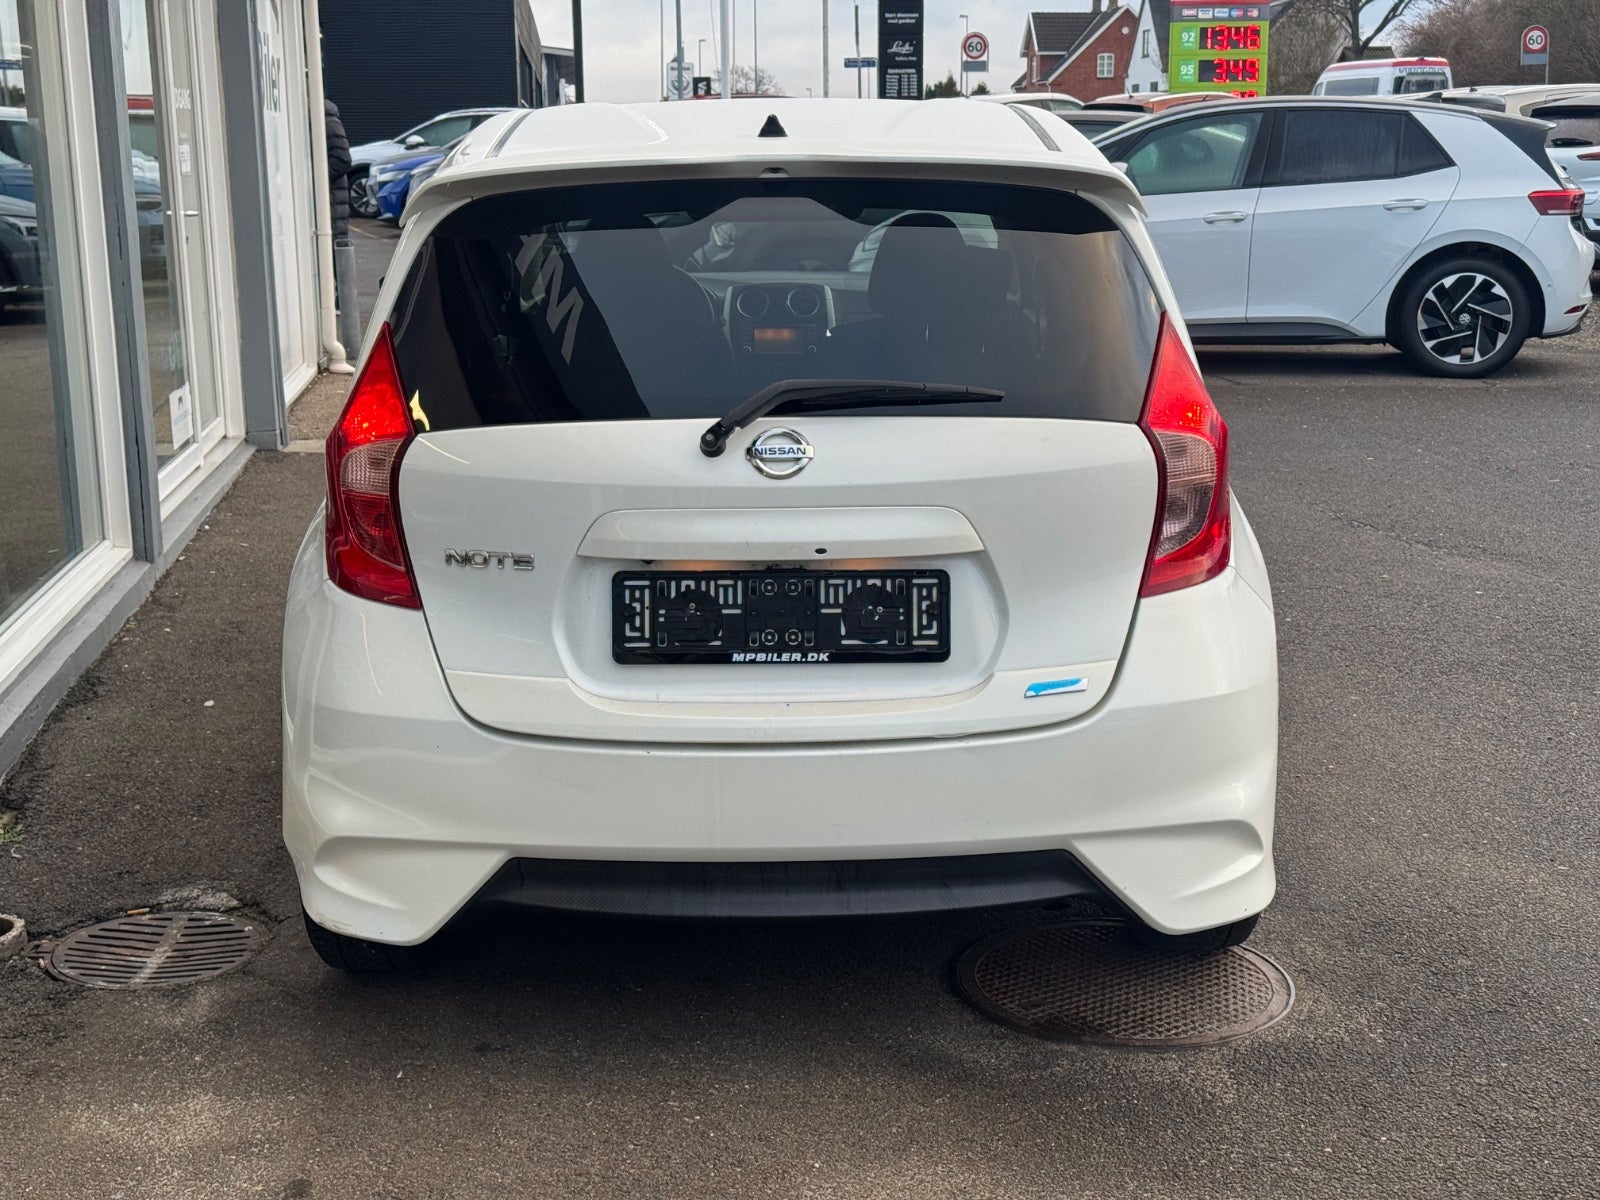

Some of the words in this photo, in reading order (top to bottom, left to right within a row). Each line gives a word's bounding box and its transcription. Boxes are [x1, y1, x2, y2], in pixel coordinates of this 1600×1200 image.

[1181, 32, 1195, 42] 92
[1527, 34, 1543, 45] 60
[967, 41, 983, 53] 60
[1180, 65, 1194, 75] 95
[753, 447, 806, 455] NISSAN
[445, 548, 535, 570] NOTE
[732, 652, 830, 662] MPBILER.DK
